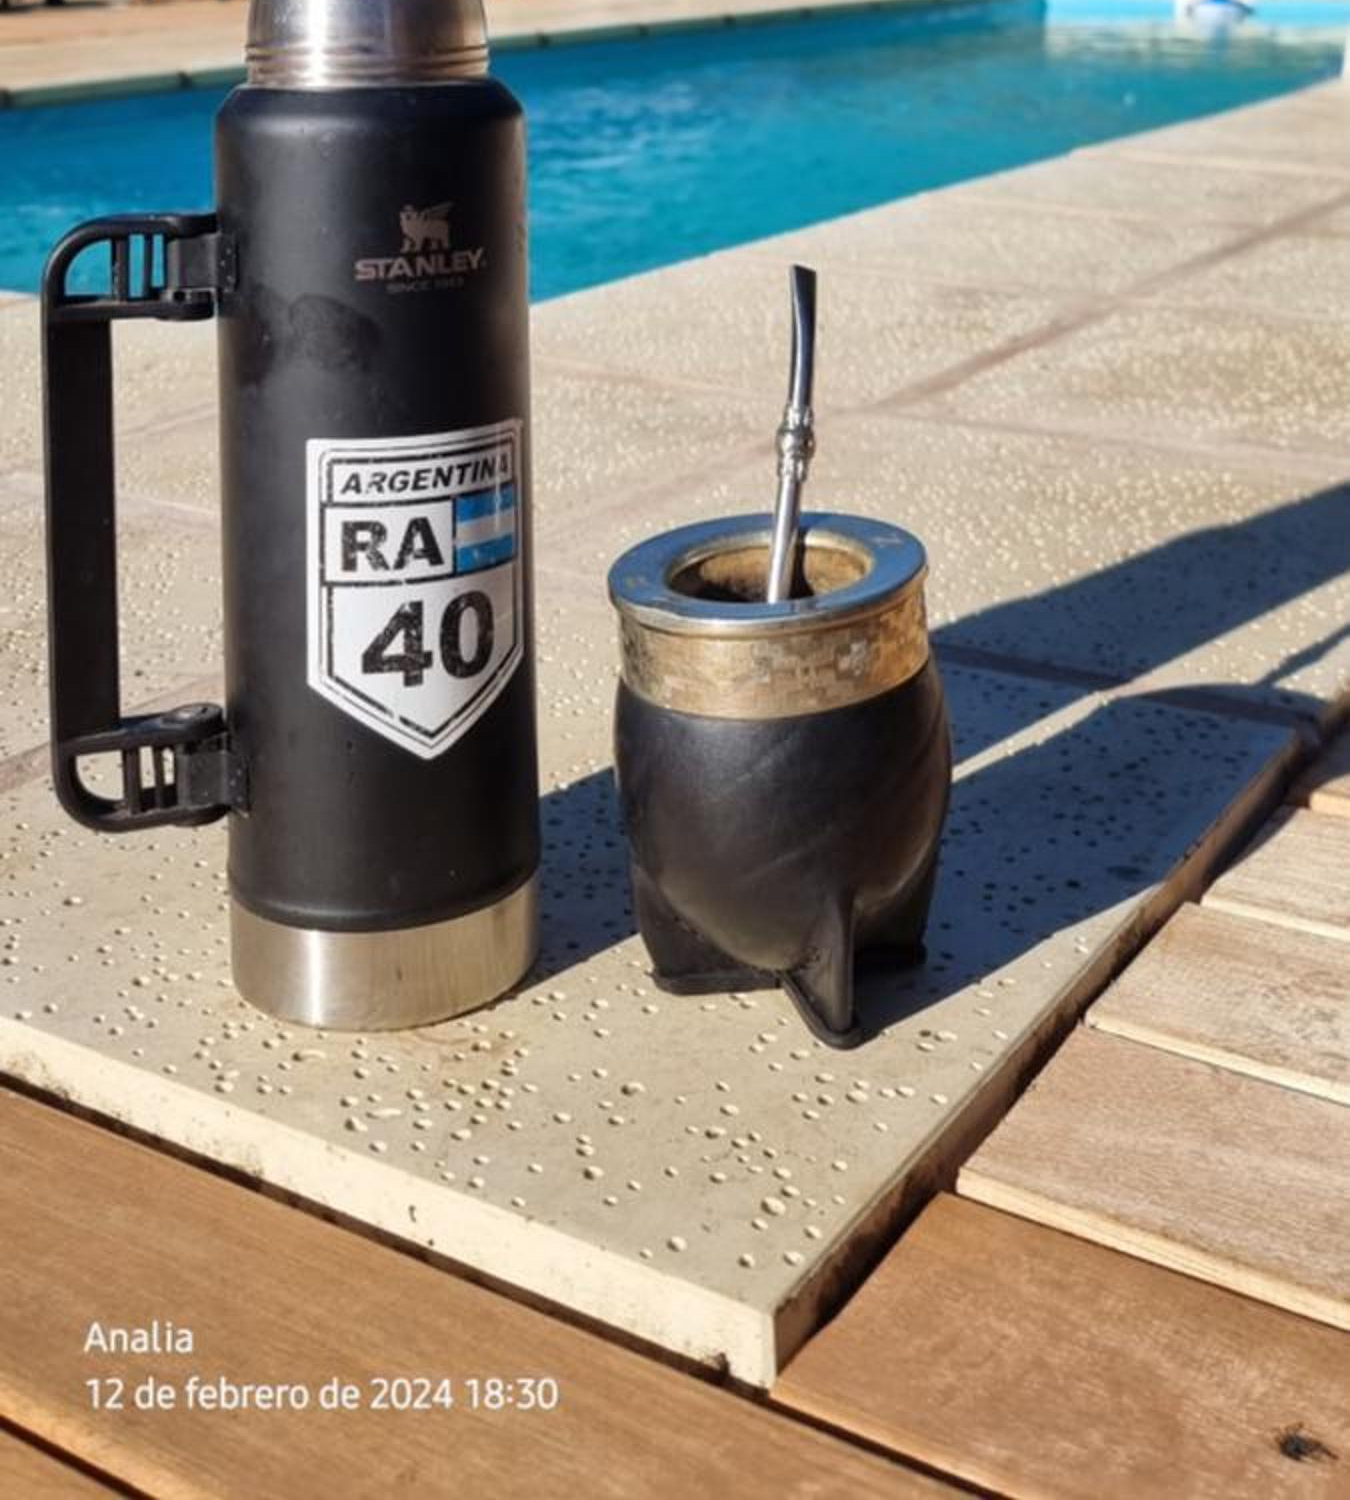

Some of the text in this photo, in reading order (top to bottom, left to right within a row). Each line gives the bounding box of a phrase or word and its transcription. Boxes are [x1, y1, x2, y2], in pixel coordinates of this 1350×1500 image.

[354, 247, 484, 280] STANLEY
[341, 453, 508, 495] ARGENTINA
[341, 516, 444, 572] RA
[361, 591, 495, 688] 40
